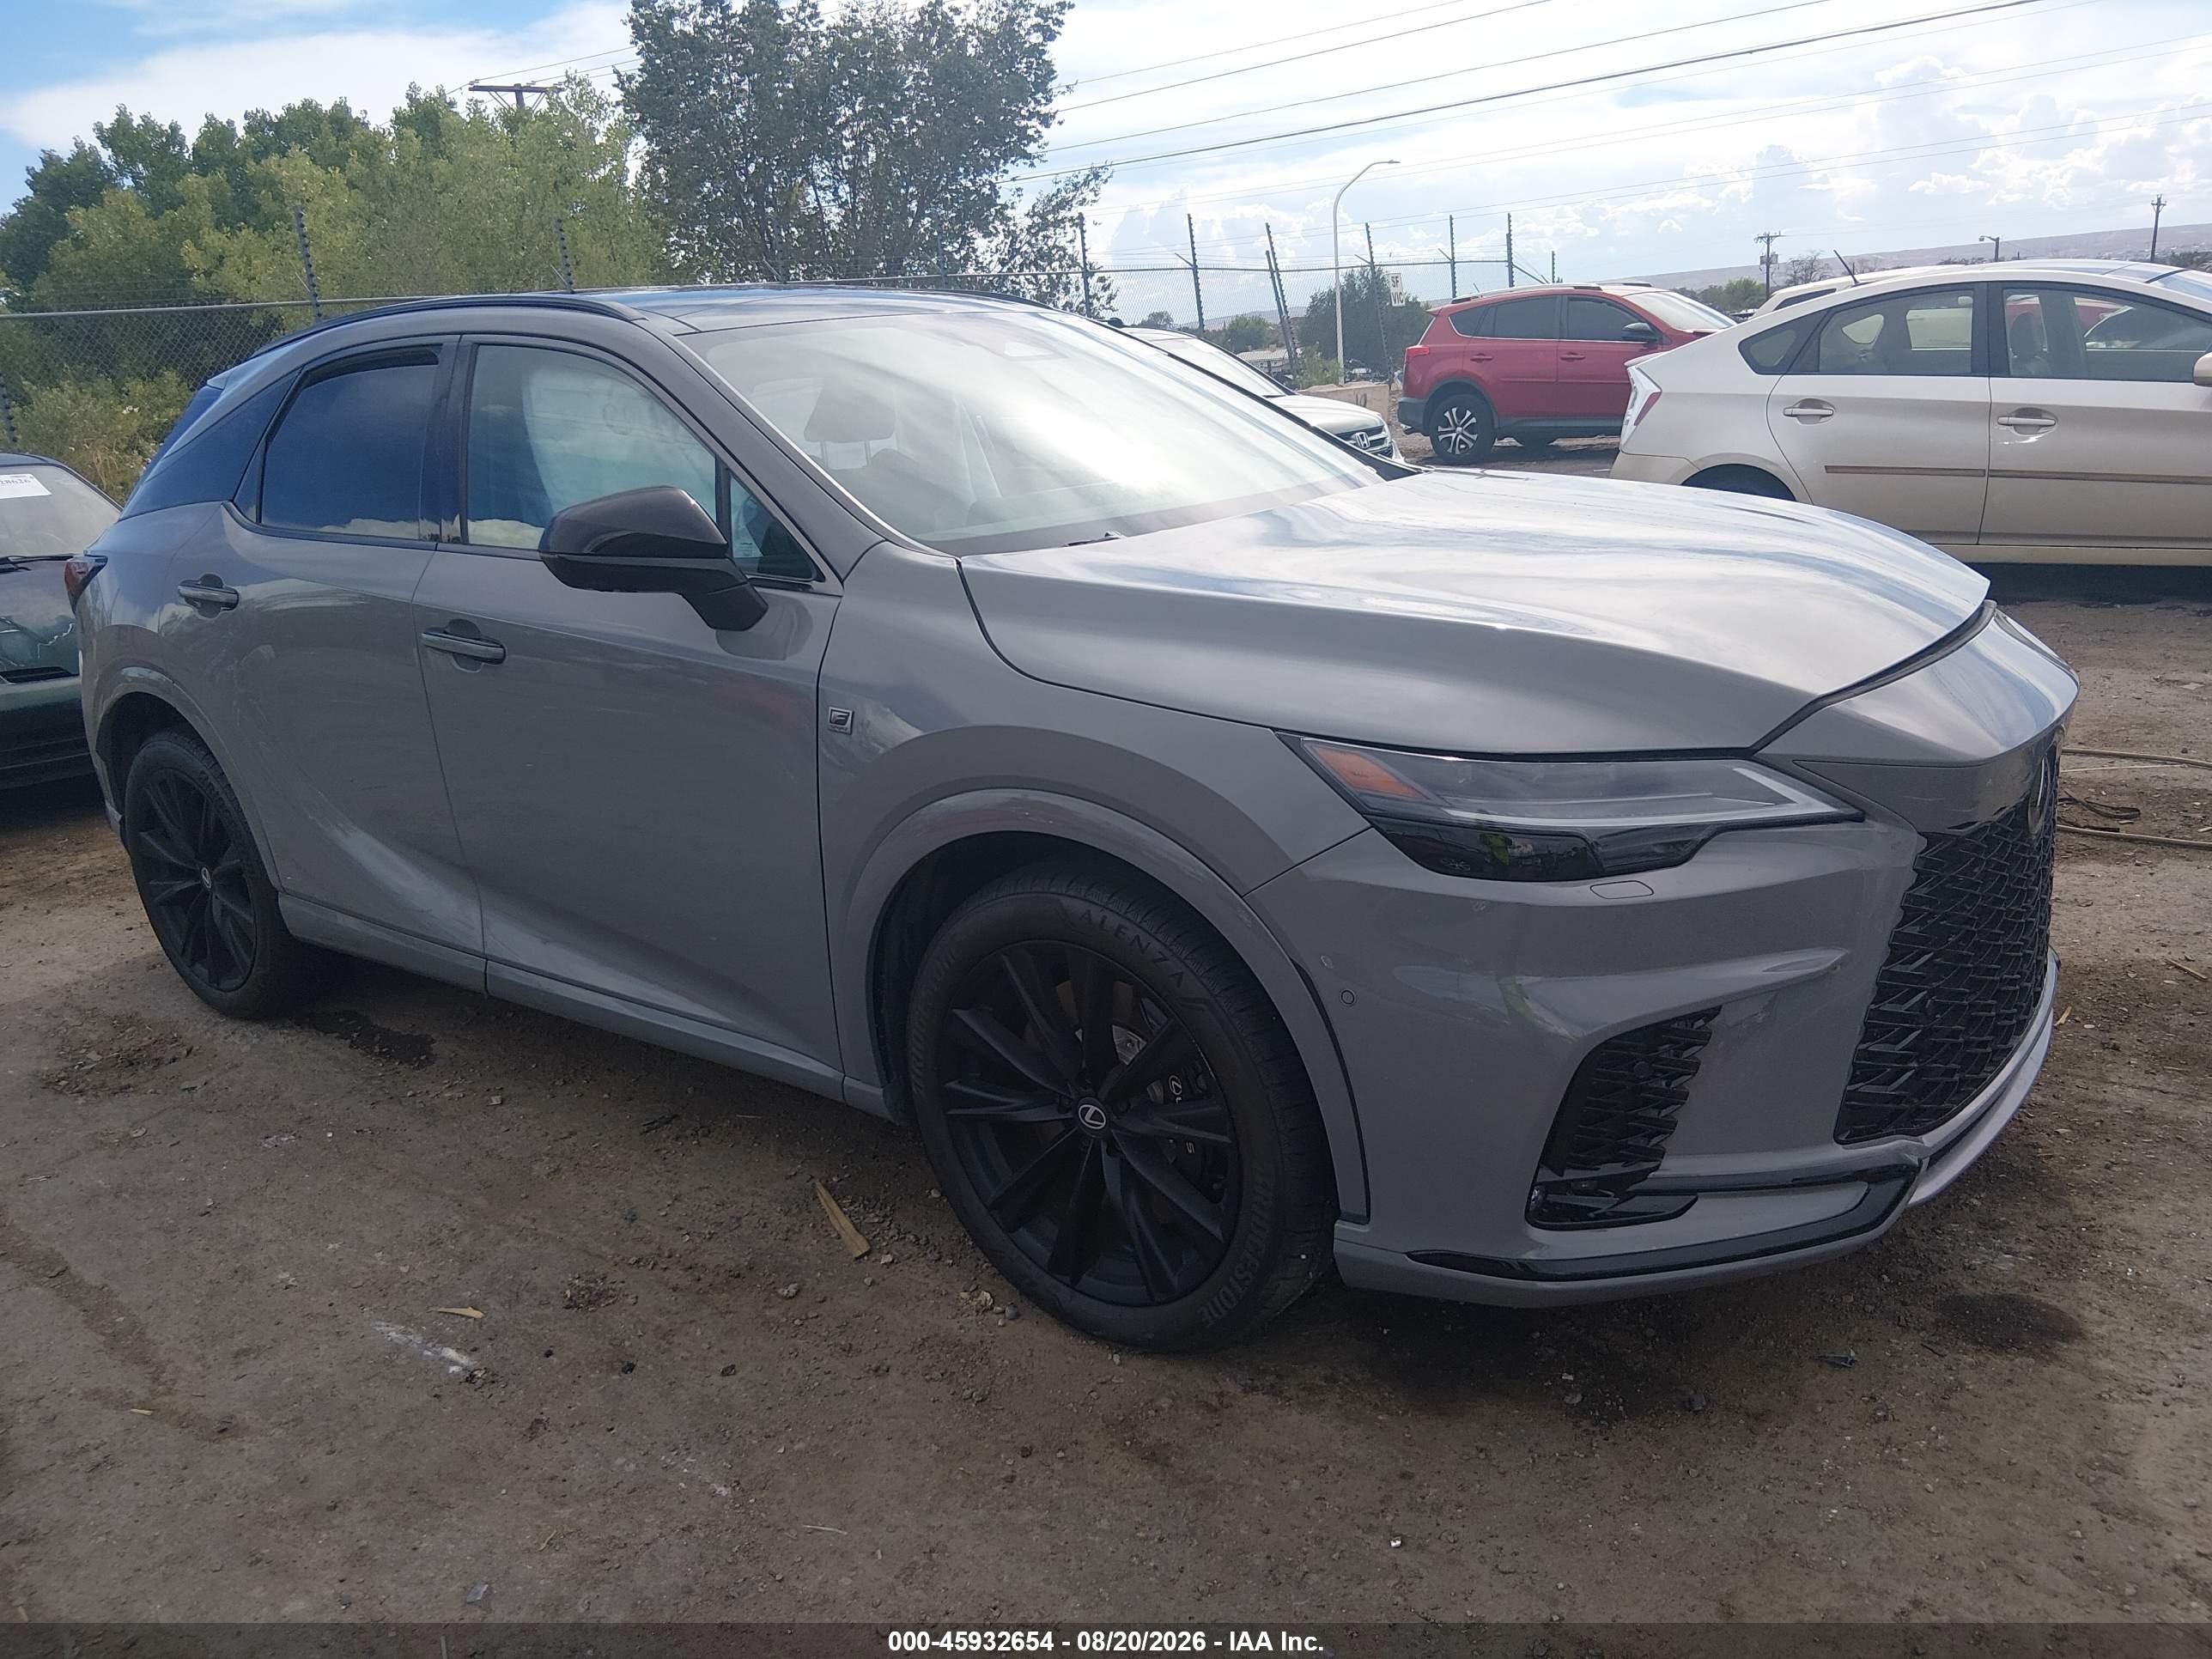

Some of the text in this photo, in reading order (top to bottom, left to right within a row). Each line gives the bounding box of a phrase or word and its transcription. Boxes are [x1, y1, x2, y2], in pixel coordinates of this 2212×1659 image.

[1391, 276, 1400, 289] SF
[1391, 291, 1404, 304] VIC
[1078, 908, 1185, 989] ALENZA
